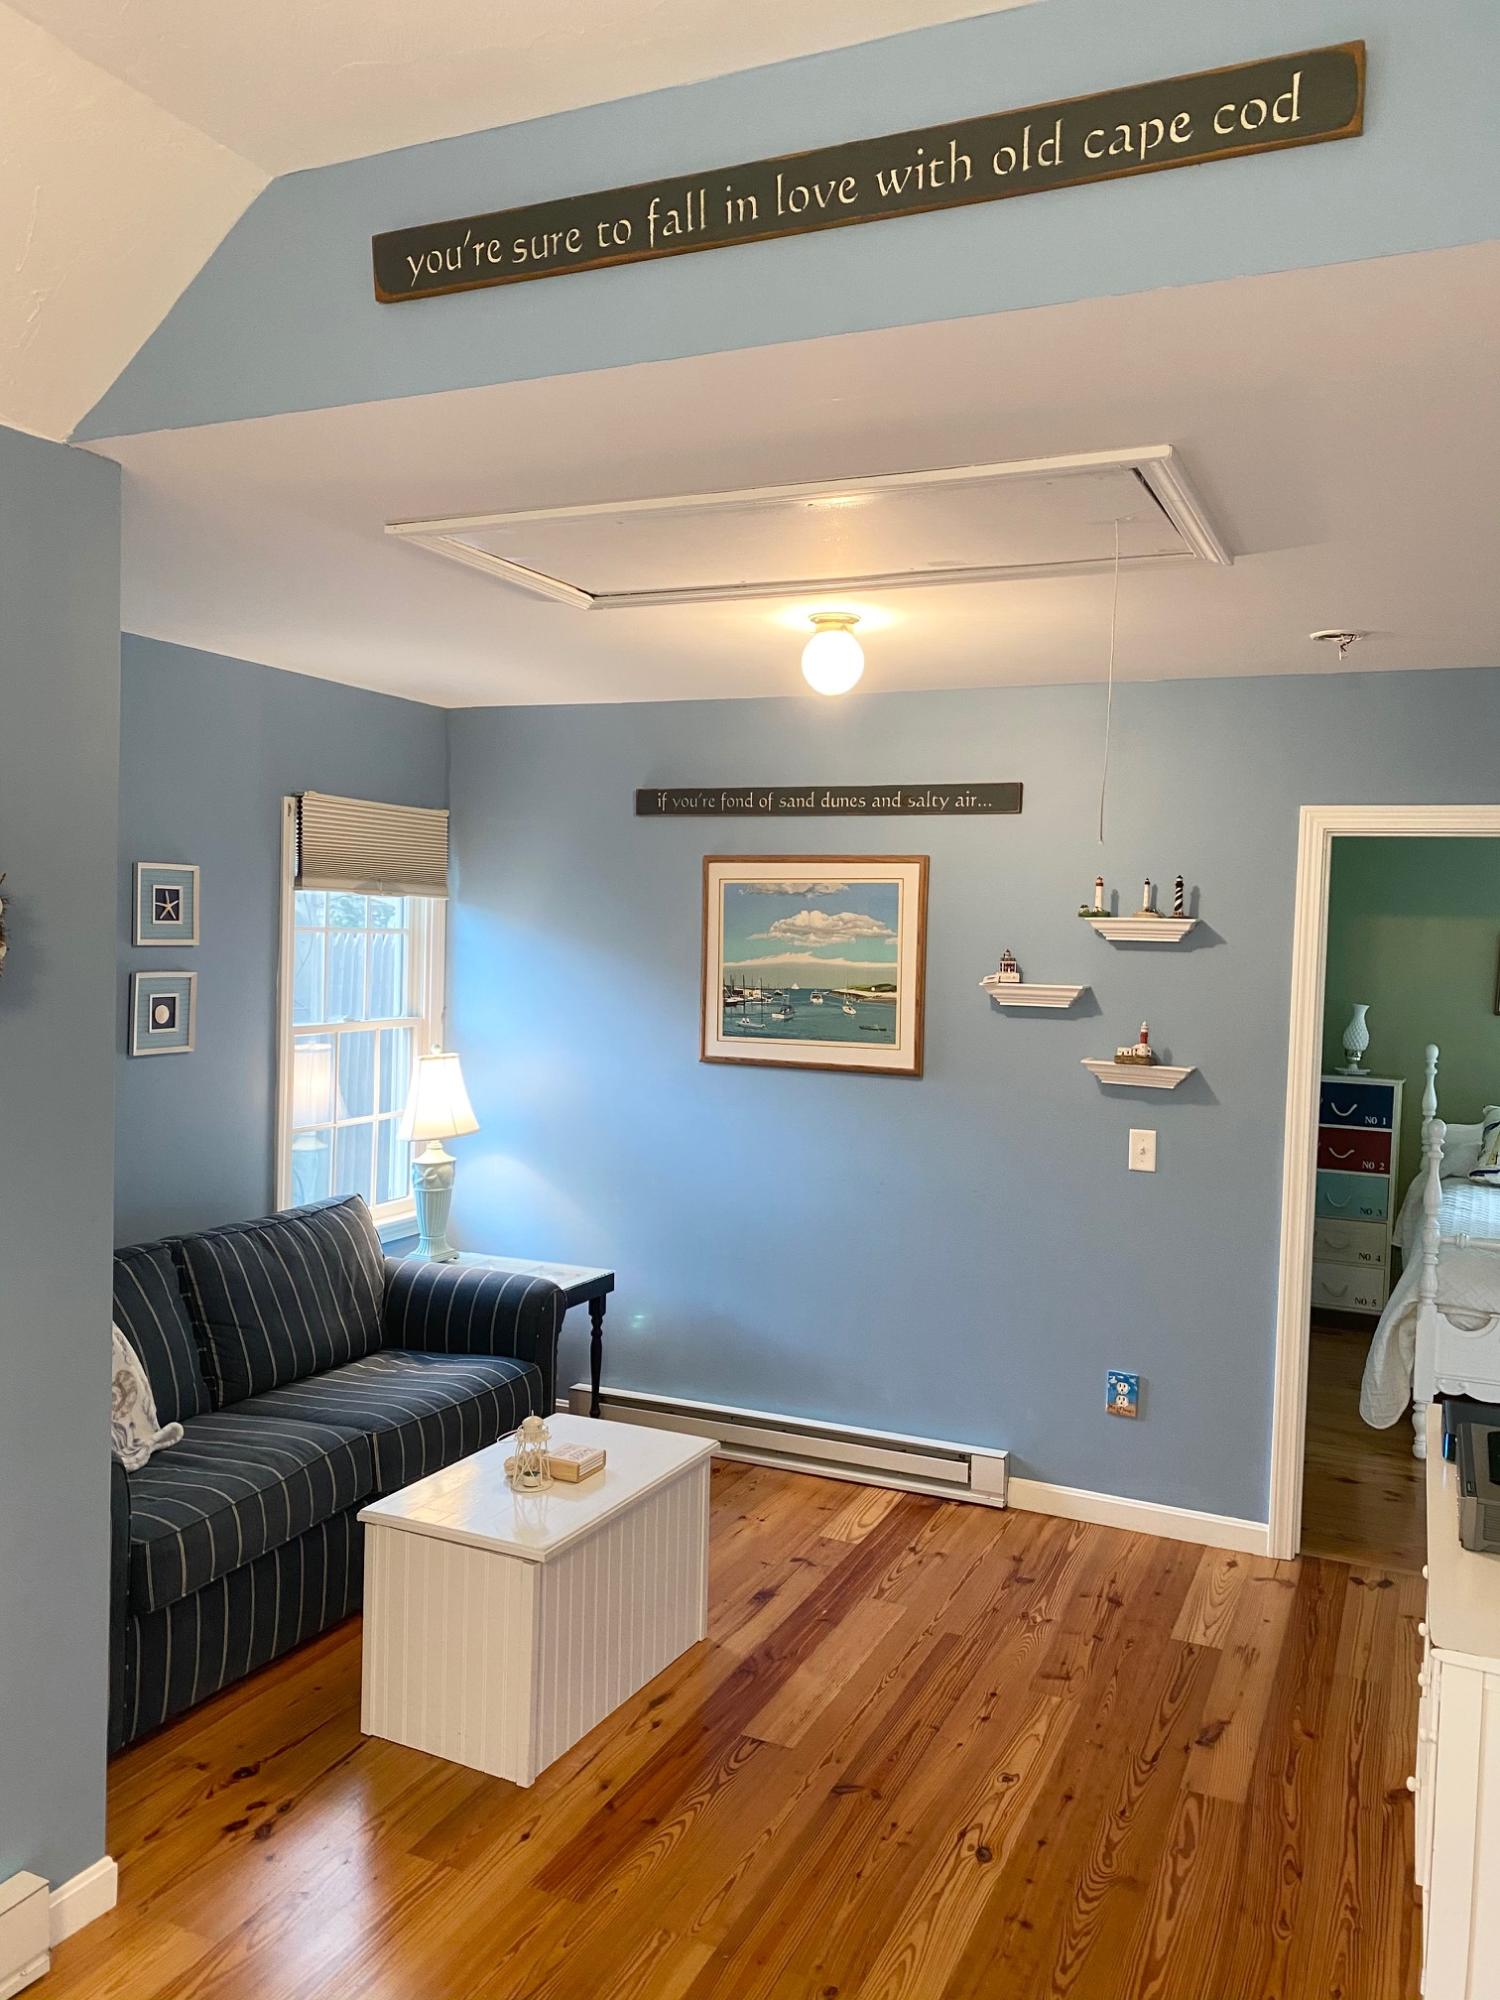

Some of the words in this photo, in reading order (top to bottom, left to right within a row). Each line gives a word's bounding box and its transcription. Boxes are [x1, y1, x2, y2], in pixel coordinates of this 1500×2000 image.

[406, 230, 501, 287] you're
[511, 228, 583, 264] sure
[597, 218, 632, 249] to
[647, 188, 706, 249] fall
[725, 185, 759, 225] in
[776, 173, 859, 217] love
[876, 139, 973, 198] with
[992, 118, 1063, 176] old
[1084, 110, 1193, 161] cape
[1213, 71, 1304, 135] cod
[657, 792, 668, 811] if
[720, 791, 753, 811] fond
[758, 791, 774, 811] of
[778, 792, 815, 808] sand
[820, 791, 866, 808] dunes
[872, 792, 901, 808] and
[907, 790, 949, 810] salty
[955, 790, 992, 808] air...
